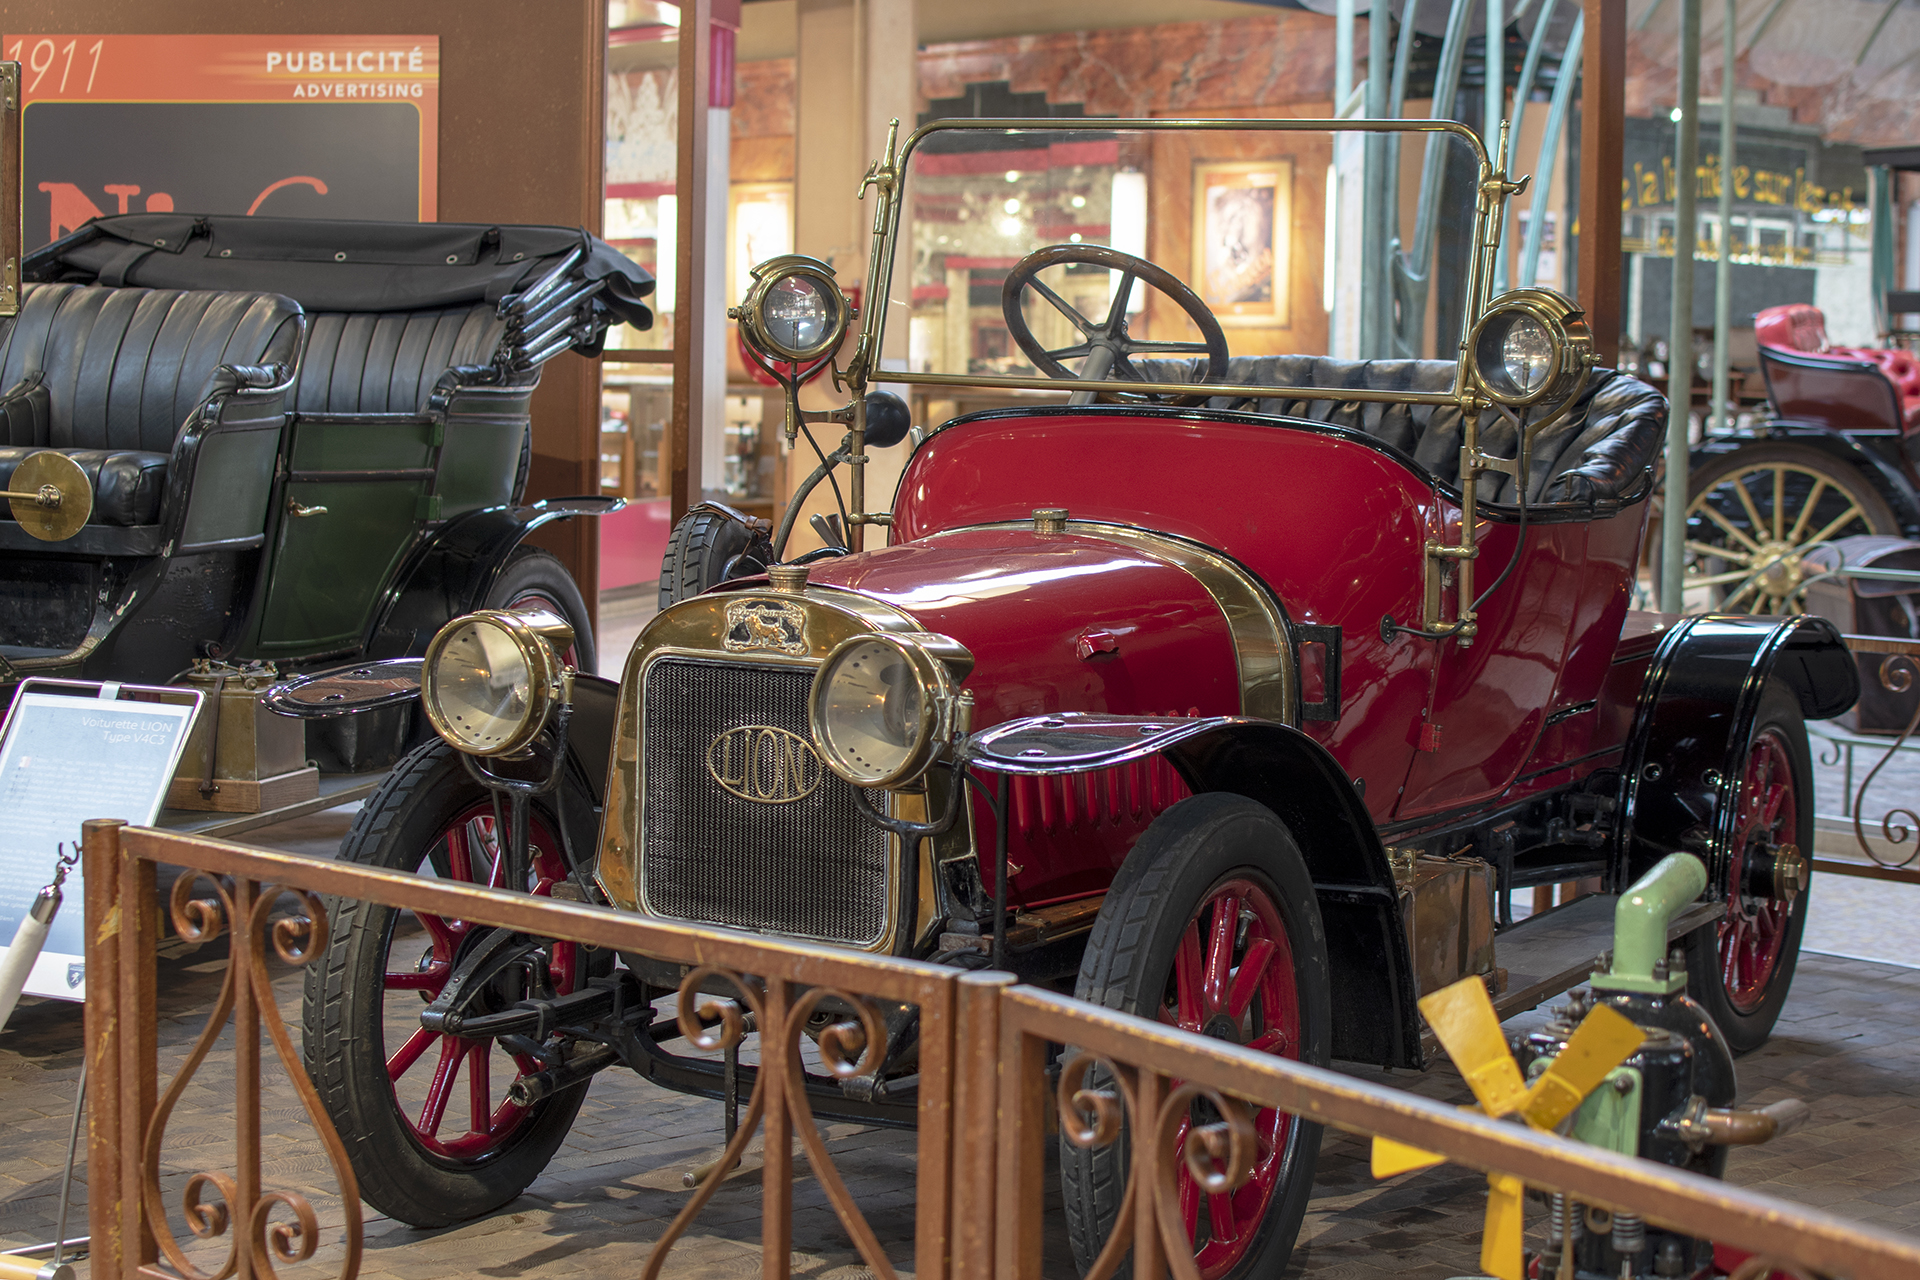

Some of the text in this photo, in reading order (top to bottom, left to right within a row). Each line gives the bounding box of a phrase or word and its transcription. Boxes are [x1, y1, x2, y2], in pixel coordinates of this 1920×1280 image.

[266, 46, 424, 73] PUBLICITÉ
[293, 83, 424, 98] ADVERTISING
[1753, 170, 1792, 206] sur
[82, 716, 173, 733] Voiturette LION
[103, 730, 166, 745] Type V4C3
[721, 729, 805, 799] LION
